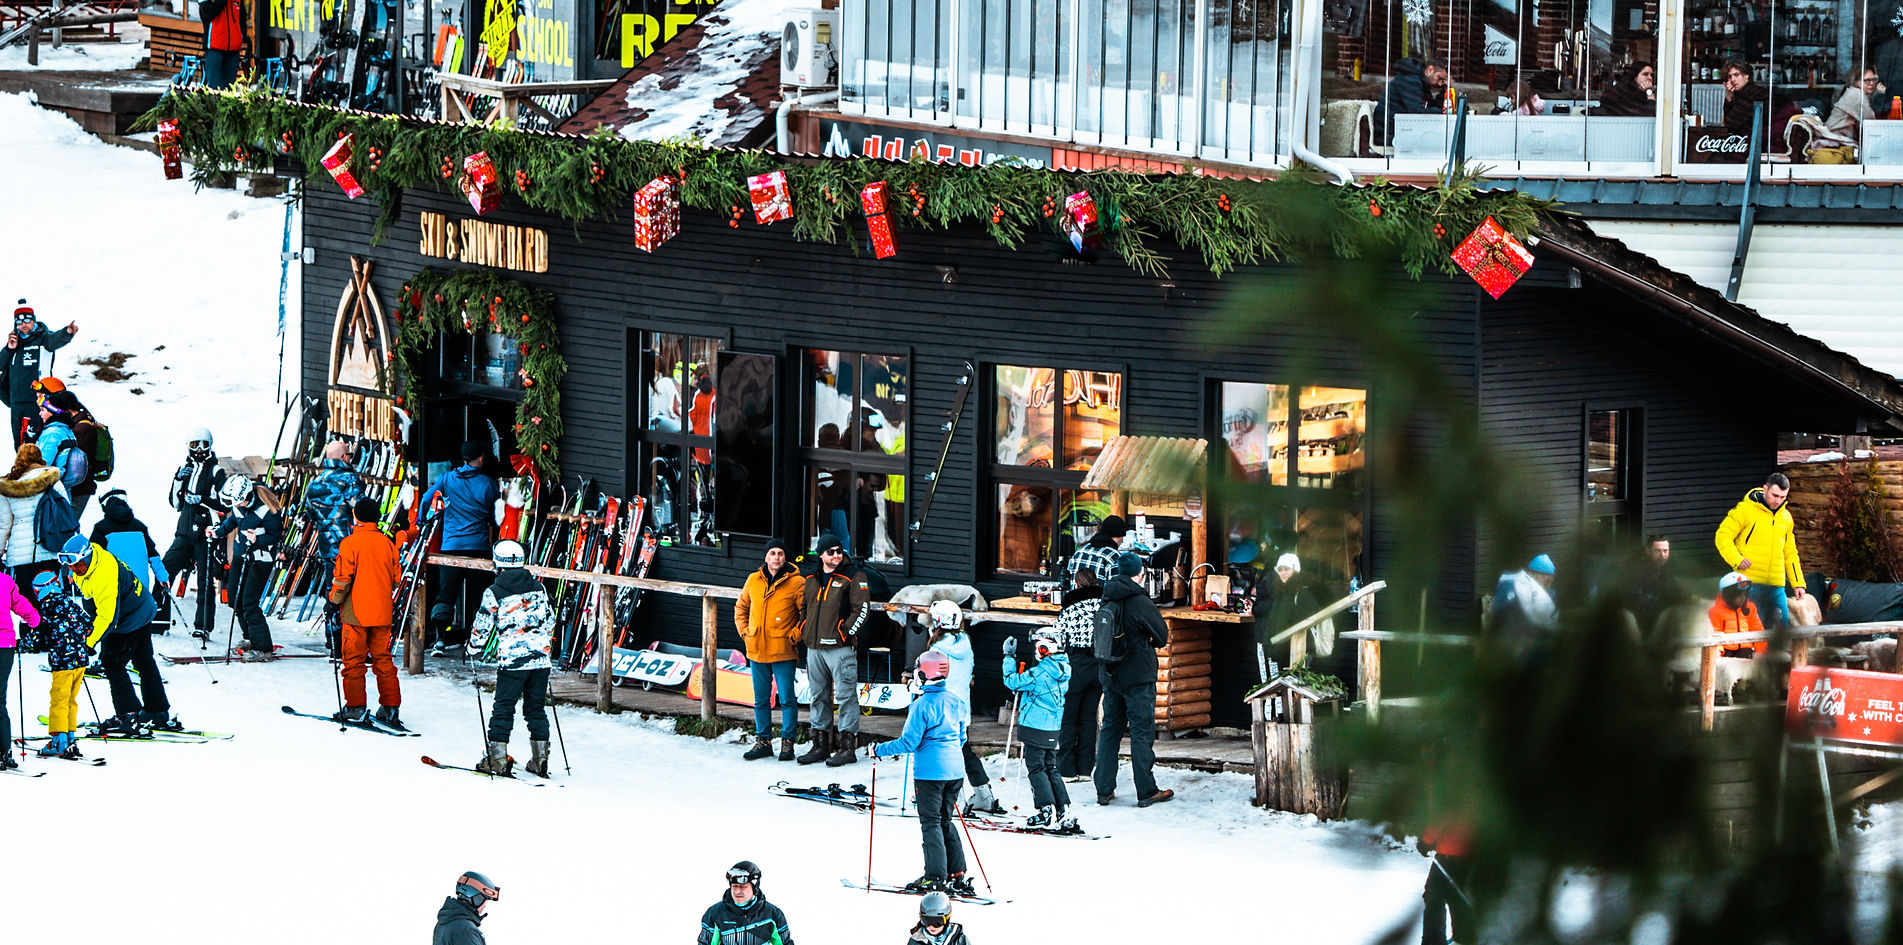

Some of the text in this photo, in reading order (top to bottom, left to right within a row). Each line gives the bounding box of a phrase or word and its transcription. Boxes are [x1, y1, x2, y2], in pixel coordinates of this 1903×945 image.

[516, 14, 573, 68] SCHOOL
[1695, 134, 1748, 153] Coca-Cola
[420, 211, 548, 273] SKI & SNOWBOARD
[327, 389, 393, 443] SPREE CLUB
[848, 601, 868, 636] OFFROAD
[1868, 699, 1895, 711] FEEL
